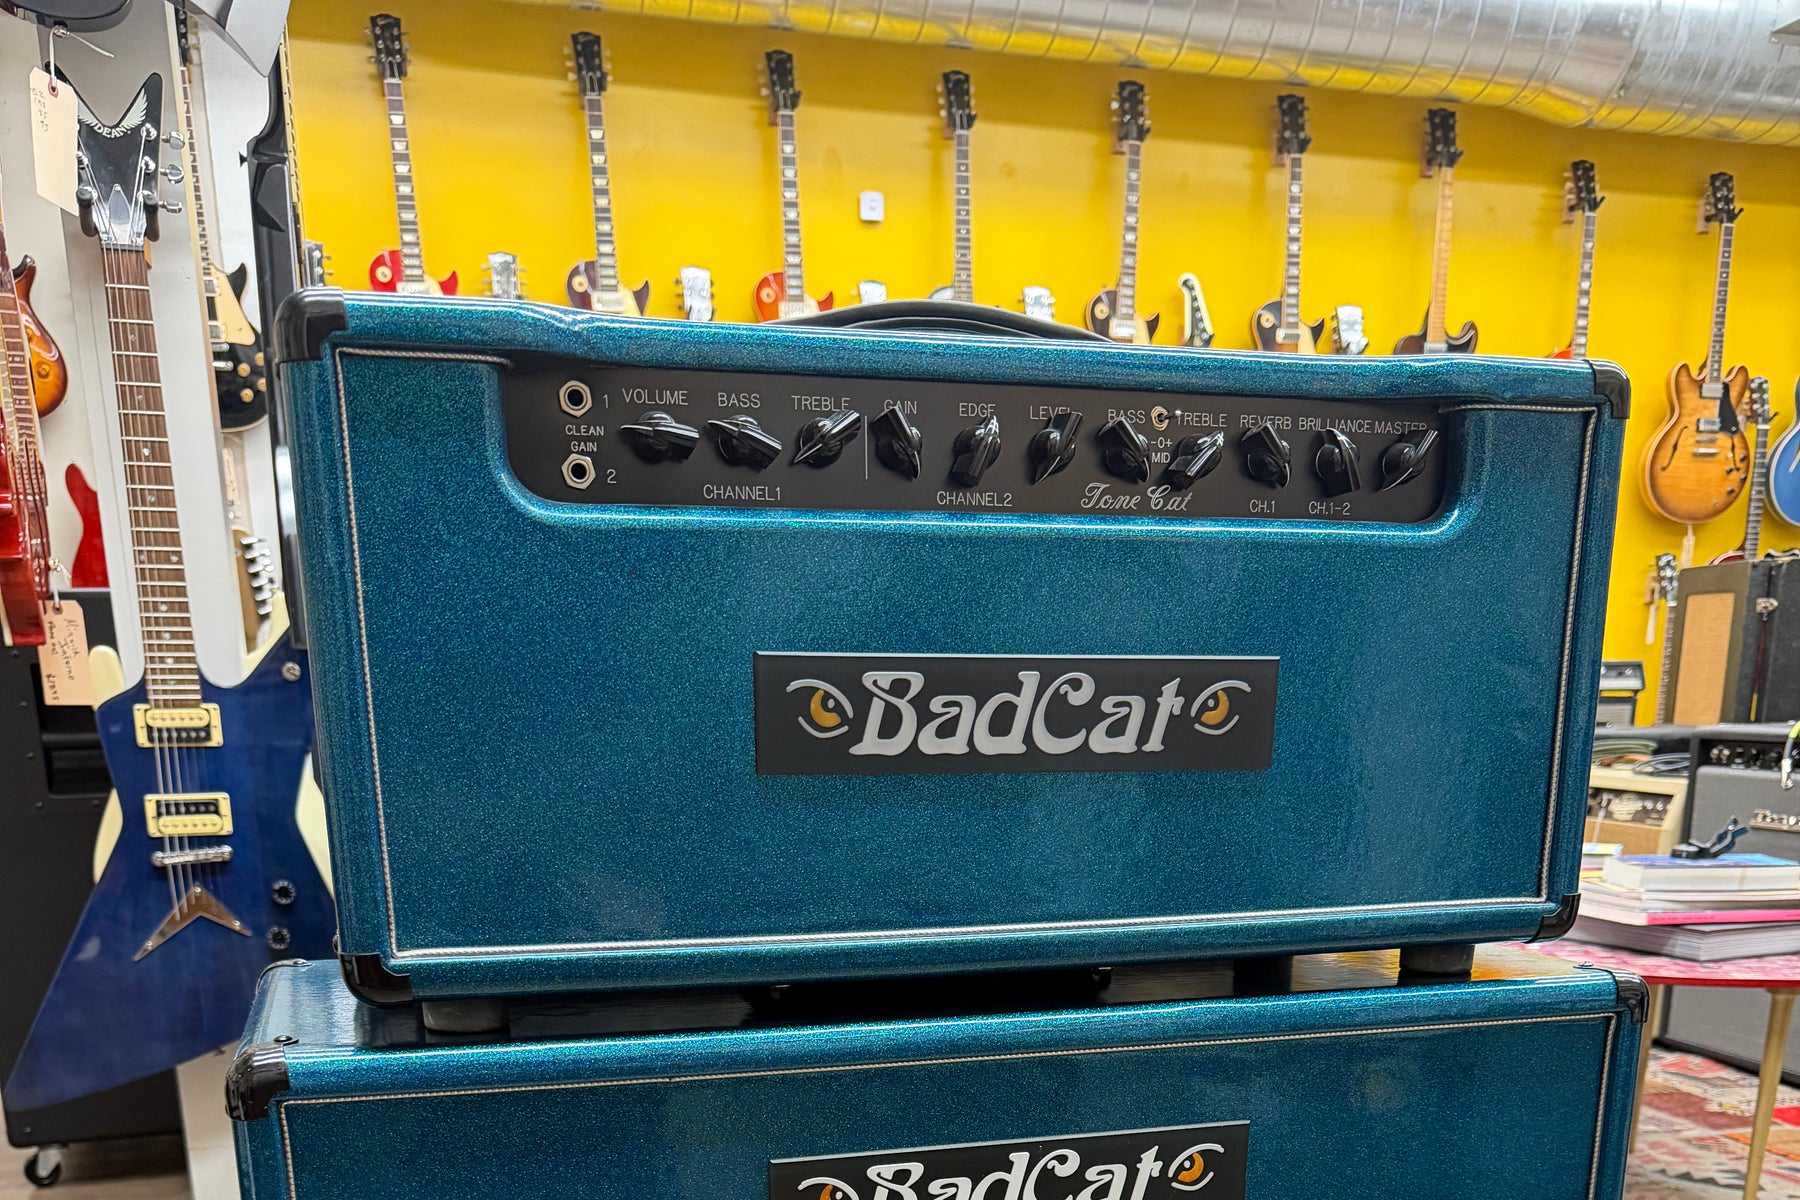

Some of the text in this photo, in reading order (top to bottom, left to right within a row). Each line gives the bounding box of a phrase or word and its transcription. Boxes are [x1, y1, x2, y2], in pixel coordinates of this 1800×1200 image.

[93, 124, 128, 138] DEAN
[602, 394, 609, 409] 1
[621, 388, 689, 406] VOLUME
[717, 392, 761, 409] BASS
[791, 395, 851, 411] TREBLE
[884, 399, 917, 415] GAIN
[959, 402, 997, 417] EDGE
[1107, 409, 1146, 424] BASS
[1175, 411, 1228, 427] TREBLE
[1239, 414, 1293, 430] REVERB
[565, 424, 605, 436] CLEAN
[1298, 417, 1372, 433] BRILLIANCE
[570, 441, 598, 452] GAIN
[1151, 452, 1171, 463] MID
[606, 469, 617, 484] 2
[1080, 482, 1193, 511] Tone Cat
[1249, 499, 1276, 513] CH.1
[1308, 501, 1350, 516] CH.1-2
[848, 670, 1186, 757] BadCat
